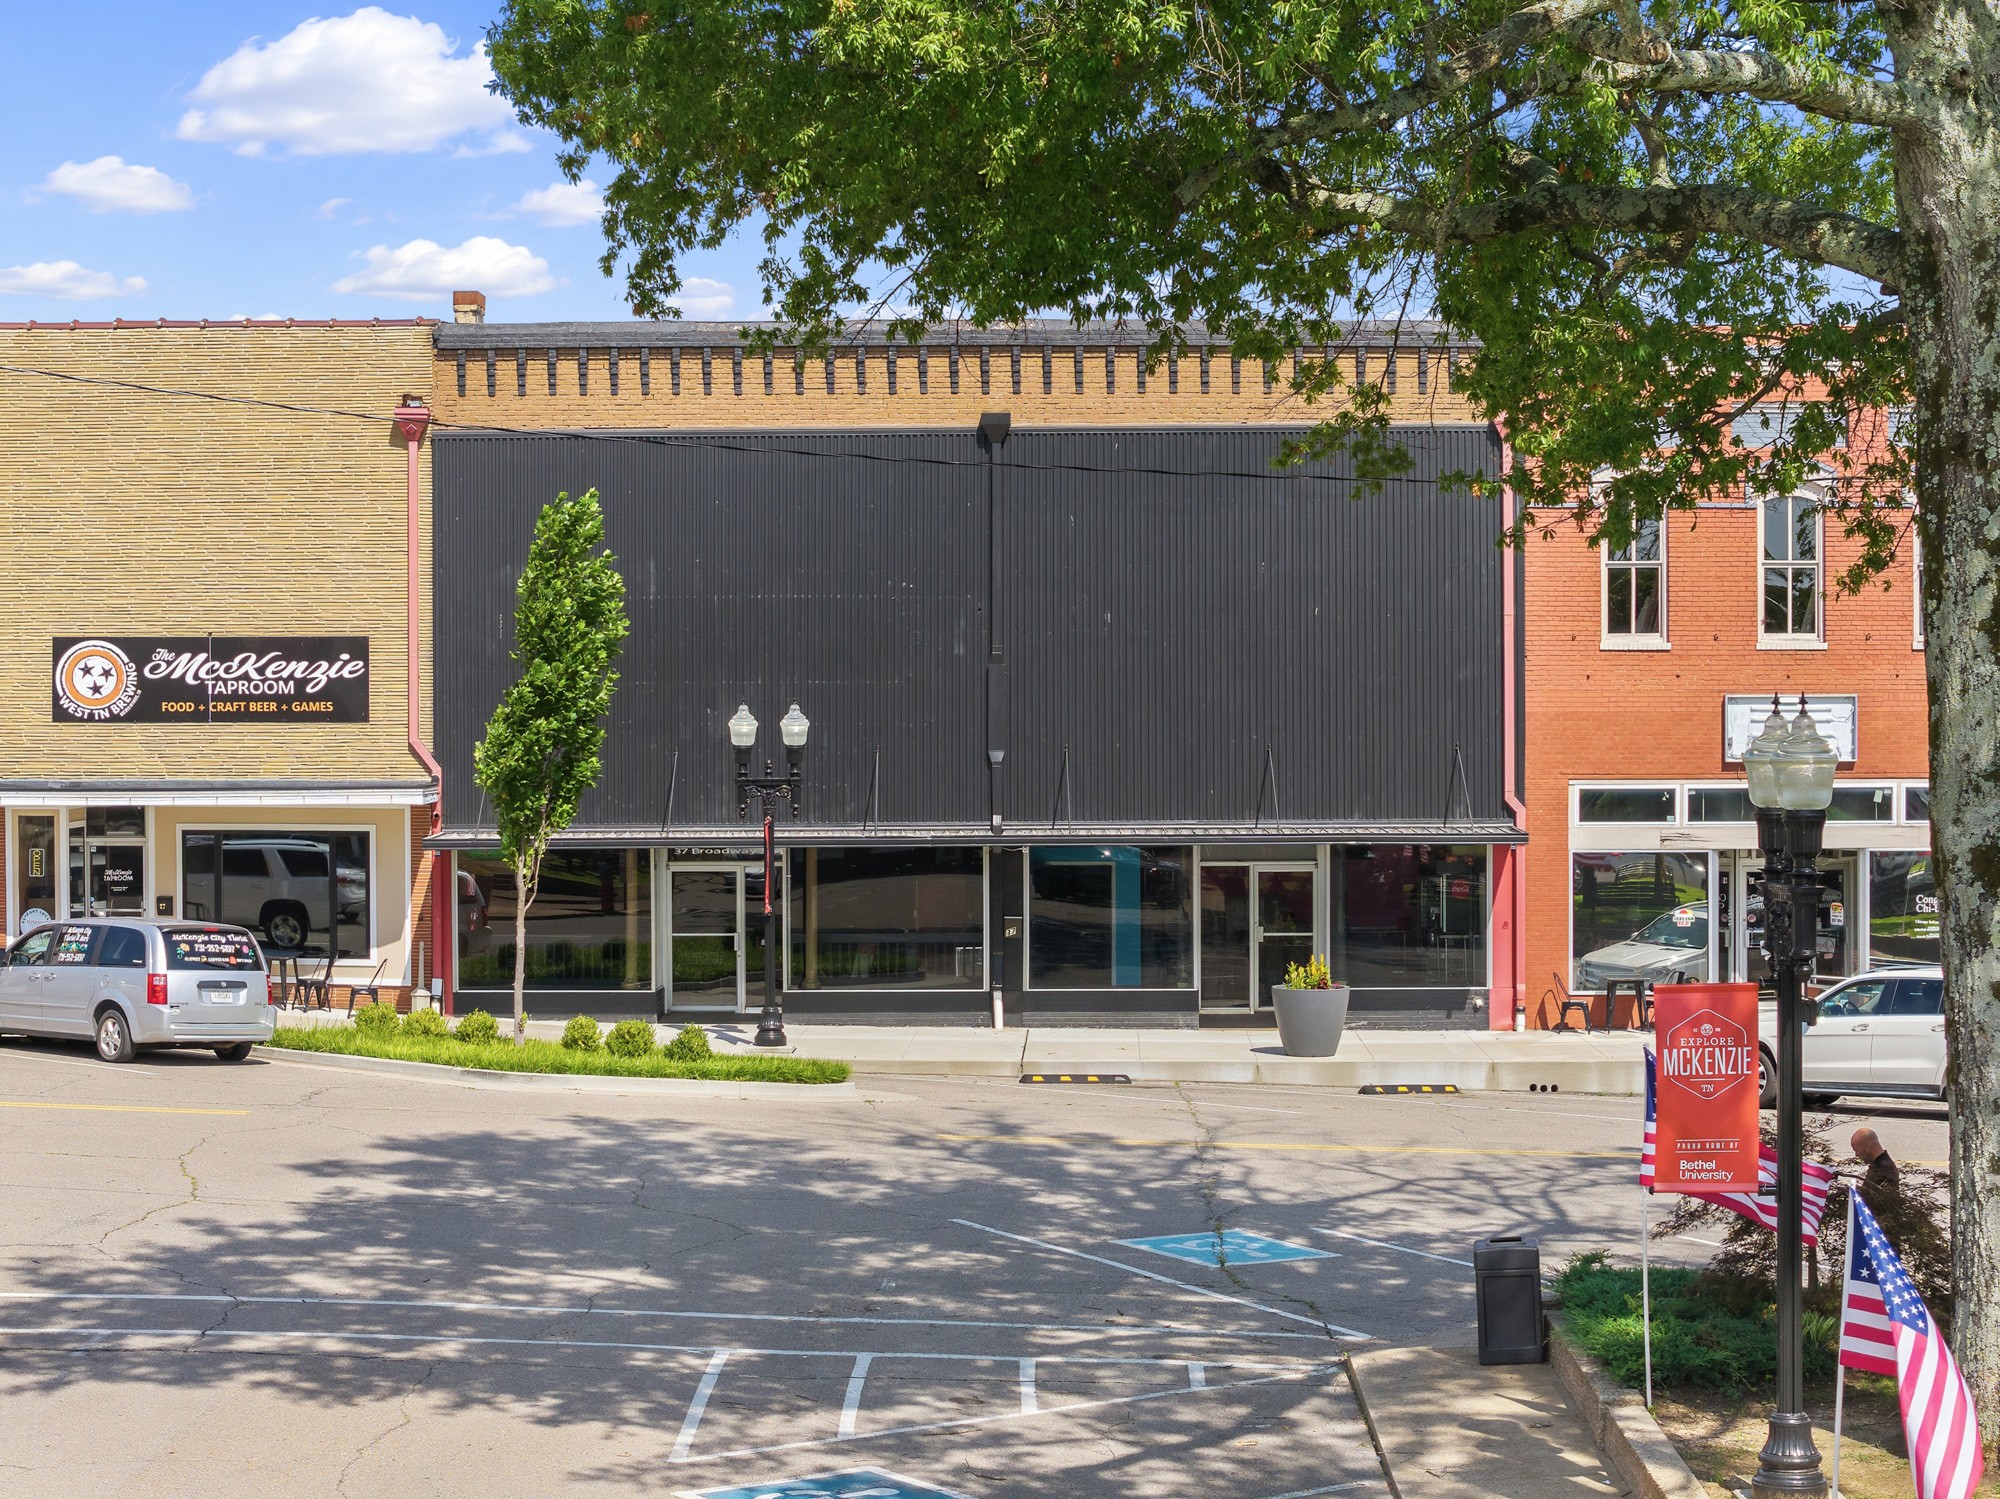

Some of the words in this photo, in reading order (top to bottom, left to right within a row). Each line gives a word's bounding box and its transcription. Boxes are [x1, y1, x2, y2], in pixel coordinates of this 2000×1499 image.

[152, 648, 176, 661] The
[143, 652, 365, 693] McKenzie
[59, 695, 91, 719] WEST
[93, 708, 111, 720] TN
[110, 662, 138, 715] BREWING
[205, 680, 295, 695] TAPROOM
[161, 701, 195, 712] FOOD
[210, 701, 246, 712] CRAFT
[249, 701, 278, 712] BEER
[291, 701, 334, 712] GAMES
[673, 847, 689, 855] 37
[691, 847, 756, 855] Broadway
[1680, 1037, 1734, 1046] EXPLORE
[1663, 1047, 1752, 1076] MCKENZIE
[1701, 1084, 1714, 1092] TN
[1679, 1159, 1716, 1170] Bethel
[1679, 1169, 1734, 1182] University
